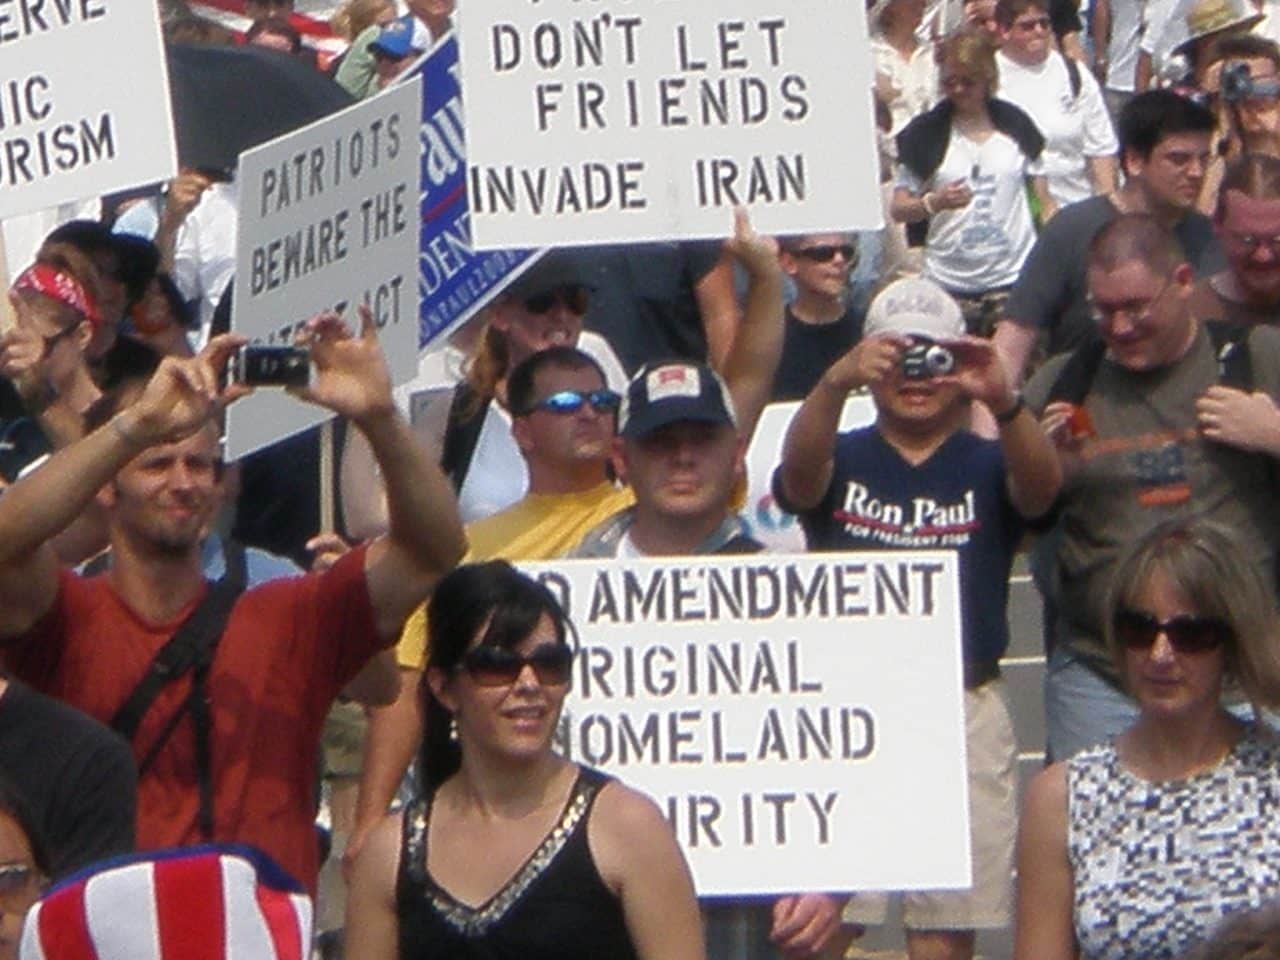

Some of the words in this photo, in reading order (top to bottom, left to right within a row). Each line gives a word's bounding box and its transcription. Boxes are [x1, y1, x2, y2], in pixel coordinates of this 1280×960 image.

[491, 13, 642, 72] DON'T
[677, 19, 787, 71] LET
[535, 74, 810, 131] FRIENDS
[260, 112, 402, 218] PATRIOTS
[470, 161, 647, 215] INVADE
[696, 153, 807, 207] IRAN
[250, 209, 349, 297] BEWARE
[360, 183, 408, 249] THE
[842, 480, 903, 526] Ron
[912, 489, 976, 529] Paul
[587, 562, 944, 625] AMENDMENT
[580, 640, 823, 699] RIGINAL
